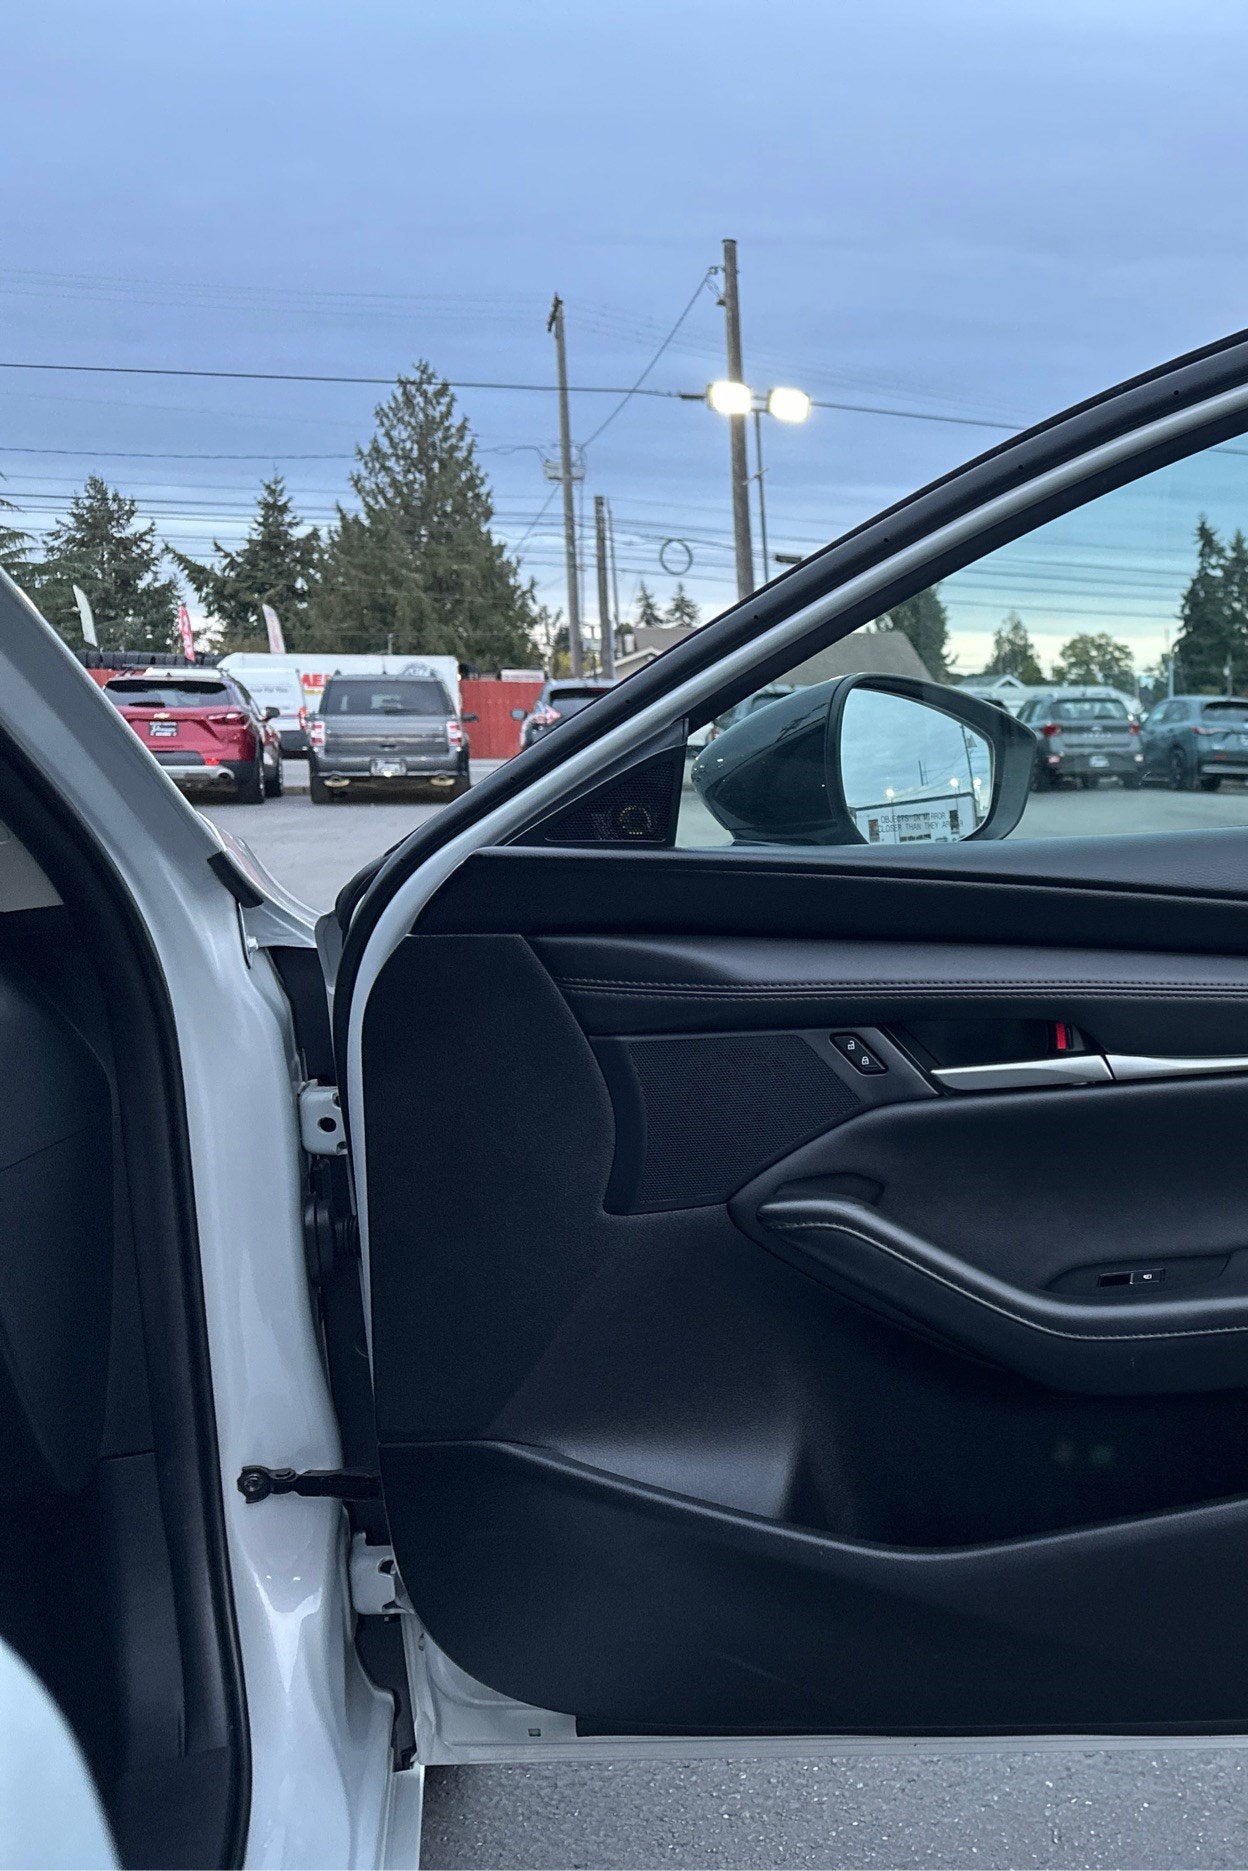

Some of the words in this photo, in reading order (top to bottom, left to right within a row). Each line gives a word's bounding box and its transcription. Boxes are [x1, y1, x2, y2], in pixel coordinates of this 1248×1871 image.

[880, 814, 909, 824] OBJECTS
[878, 823, 903, 833] CLOSER
[906, 822, 922, 831] THAN
[924, 821, 939, 830] THEY
